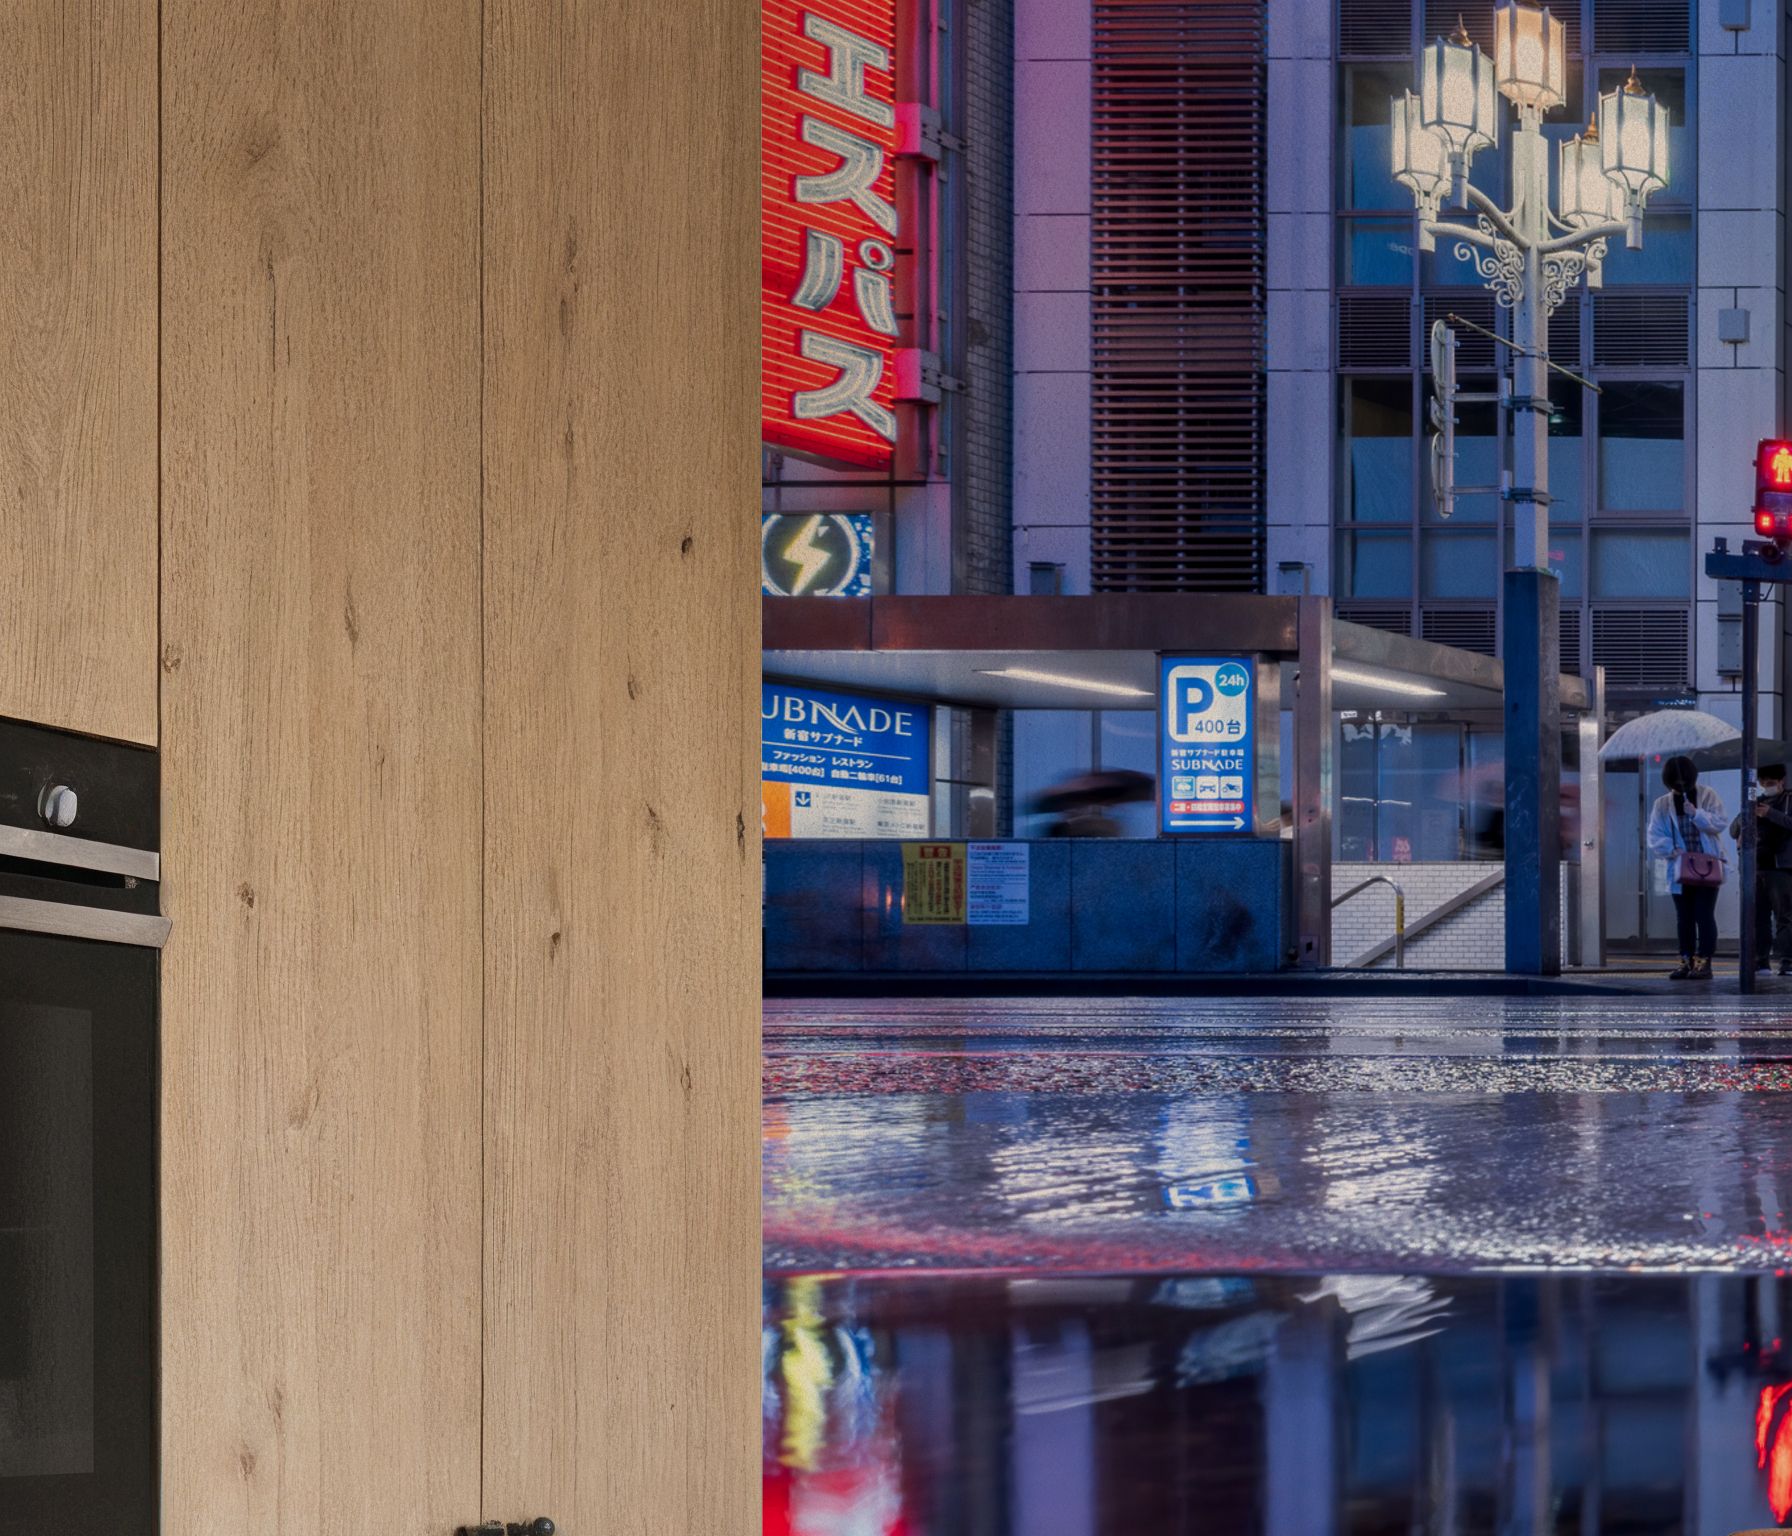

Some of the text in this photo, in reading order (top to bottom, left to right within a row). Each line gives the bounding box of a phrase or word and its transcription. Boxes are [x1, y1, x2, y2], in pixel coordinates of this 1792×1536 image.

[1219, 675, 1245, 687] 24h
[1176, 677, 1214, 736] P
[1195, 719, 1241, 735] 400台
[773, 751, 874, 769] ファッション レストラン
[1171, 759, 1244, 772] SUBNADE
